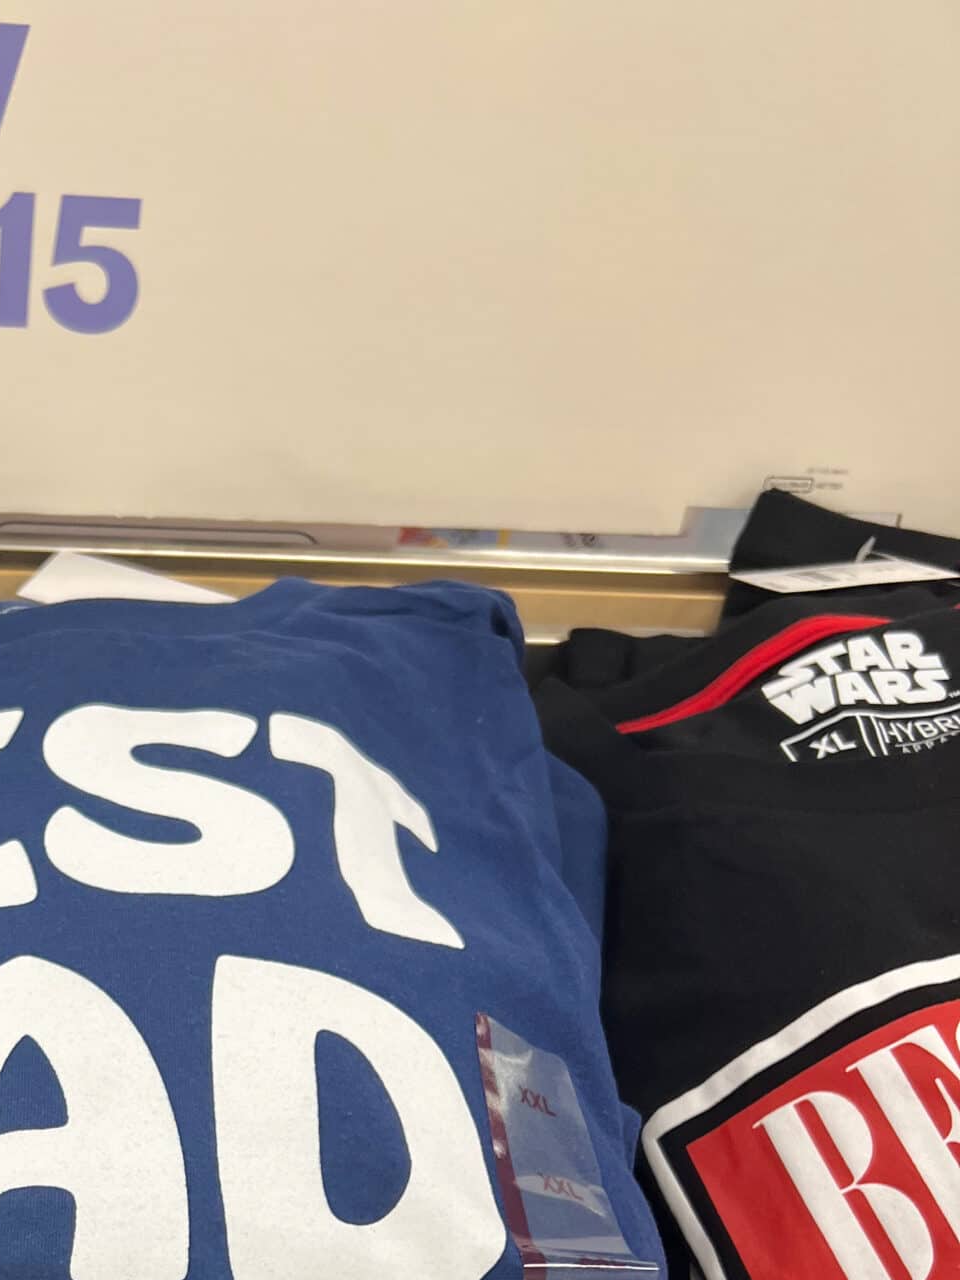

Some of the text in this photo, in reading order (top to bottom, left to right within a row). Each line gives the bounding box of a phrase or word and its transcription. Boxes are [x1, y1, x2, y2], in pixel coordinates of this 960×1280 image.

[761, 632, 942, 700] STAR
[768, 669, 950, 725] WARS
[808, 730, 857, 760] XL
[517, 1084, 558, 1118] XXL
[541, 1172, 585, 1202] XXL
